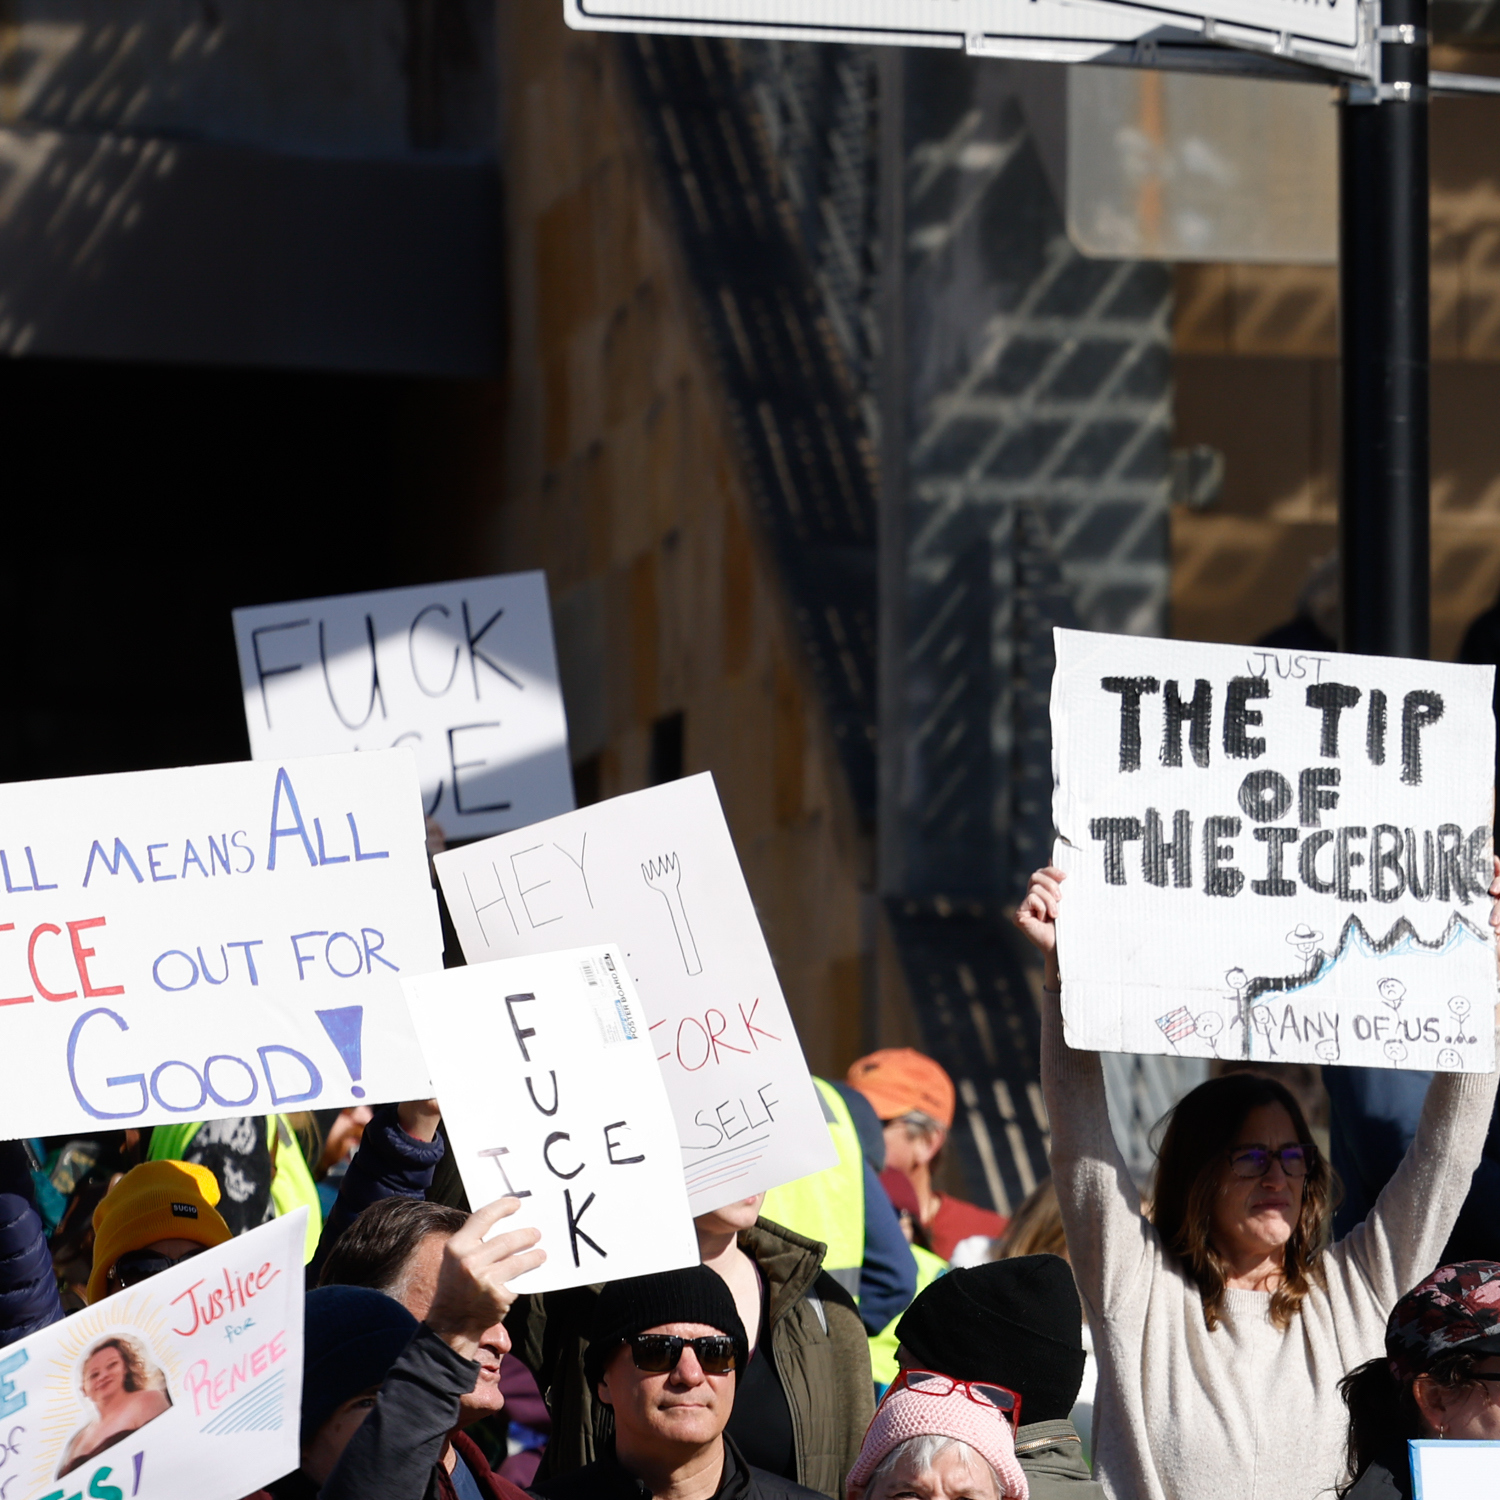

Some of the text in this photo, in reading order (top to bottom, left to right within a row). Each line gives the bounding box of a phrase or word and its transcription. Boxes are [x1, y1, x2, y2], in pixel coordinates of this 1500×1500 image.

[251, 599, 525, 730] FUCK
[1247, 651, 1330, 678] JUST
[1100, 675, 1445, 786] THE TIP
[0, 846, 58, 894] LL
[82, 829, 255, 888] MEANS
[267, 767, 390, 871] ALL
[1237, 767, 1341, 827] OF
[464, 832, 595, 948] HEY
[1088, 807, 1244, 897] THE
[152, 940, 264, 993] OUT
[292, 928, 400, 982] FOR
[66, 1004, 365, 1121] GOOD!
[1353, 1014, 1391, 1041] OF
[170, 1262, 281, 1337] Justice
[183, 1330, 288, 1416] RENEE
